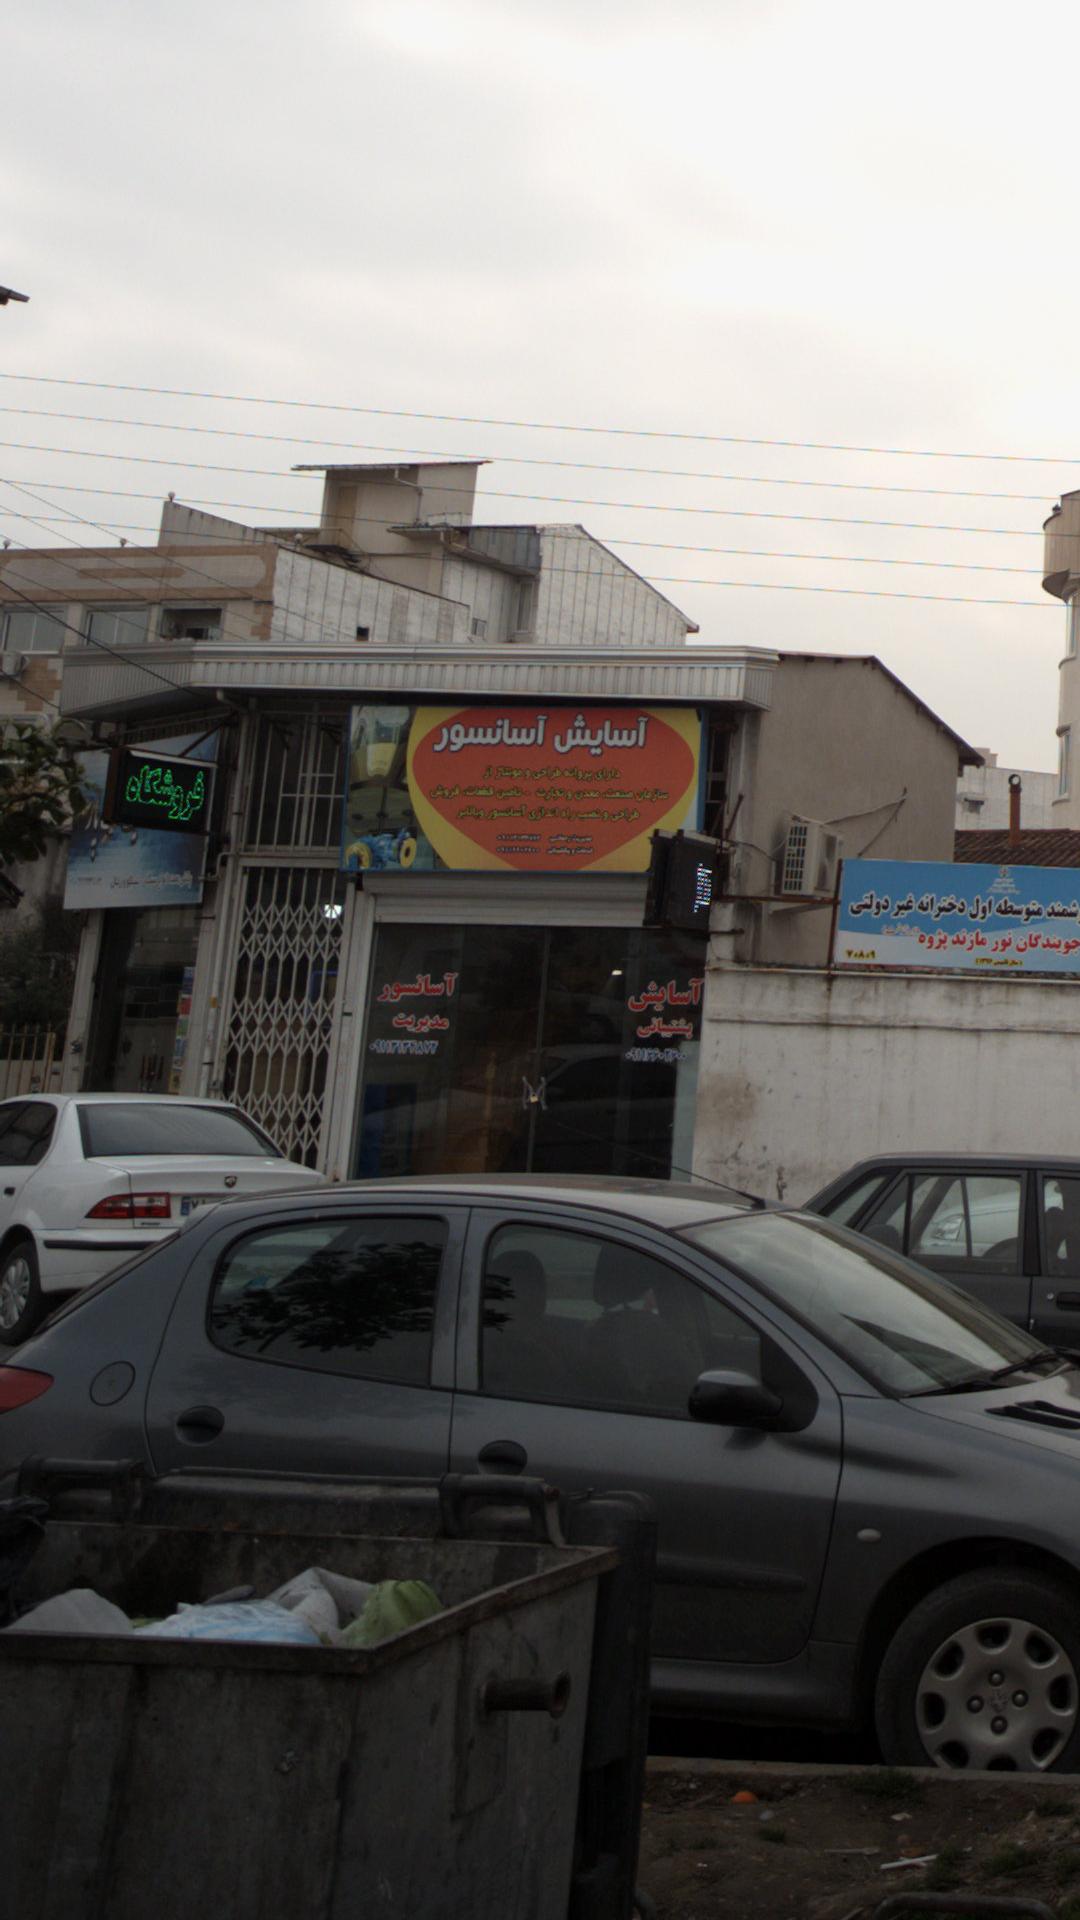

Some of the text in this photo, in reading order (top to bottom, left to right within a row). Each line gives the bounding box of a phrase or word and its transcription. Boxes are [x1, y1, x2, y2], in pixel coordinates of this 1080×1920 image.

[433, 714, 649, 754] آسایش آسانسور
[127, 765, 205, 821] فروشگاه
[849, 891, 1080, 922] شمند متوسطه اول دخترانه غیر دولتی
[990, 932, 1012, 952] نور
[377, 972, 459, 1002] آسانسور
[628, 978, 705, 1012] آسایش
[392, 1012, 449, 1033] مدیریت
[636, 1016, 693, 1039] پشتیبانی
